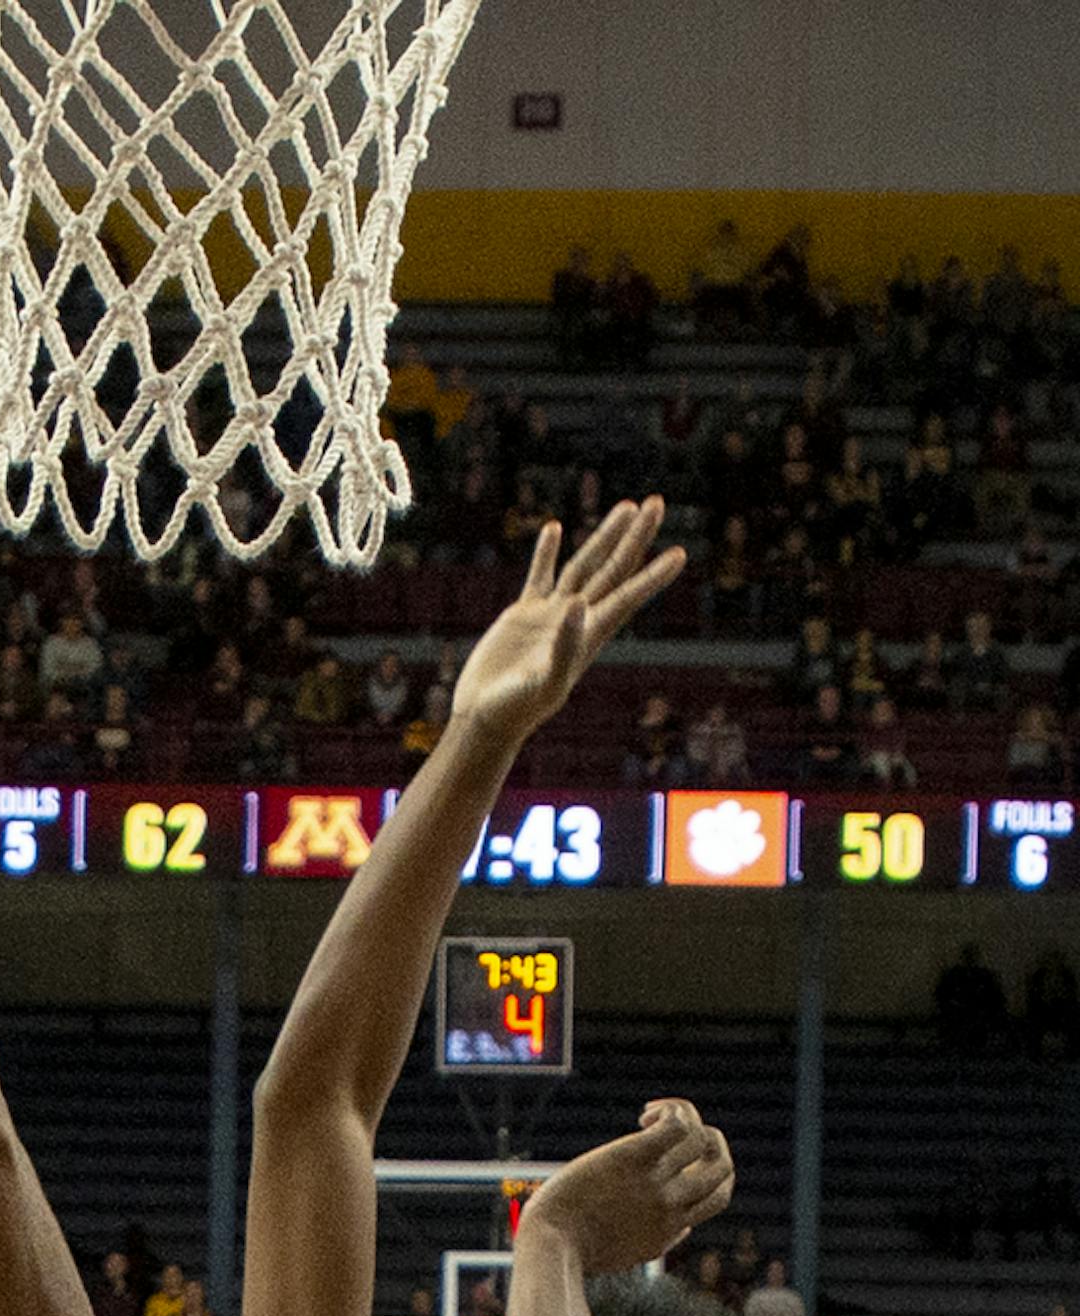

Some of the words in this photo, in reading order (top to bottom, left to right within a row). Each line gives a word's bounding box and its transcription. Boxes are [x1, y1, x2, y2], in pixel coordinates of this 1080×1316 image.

[123, 802, 208, 869] 62
[991, 800, 1074, 832] FOULS
[3, 820, 36, 870] 5
[840, 812, 925, 880] 50
[1015, 834, 1049, 886] 6
[478, 952, 558, 992] 7:43
[505, 993, 545, 1056] 4
